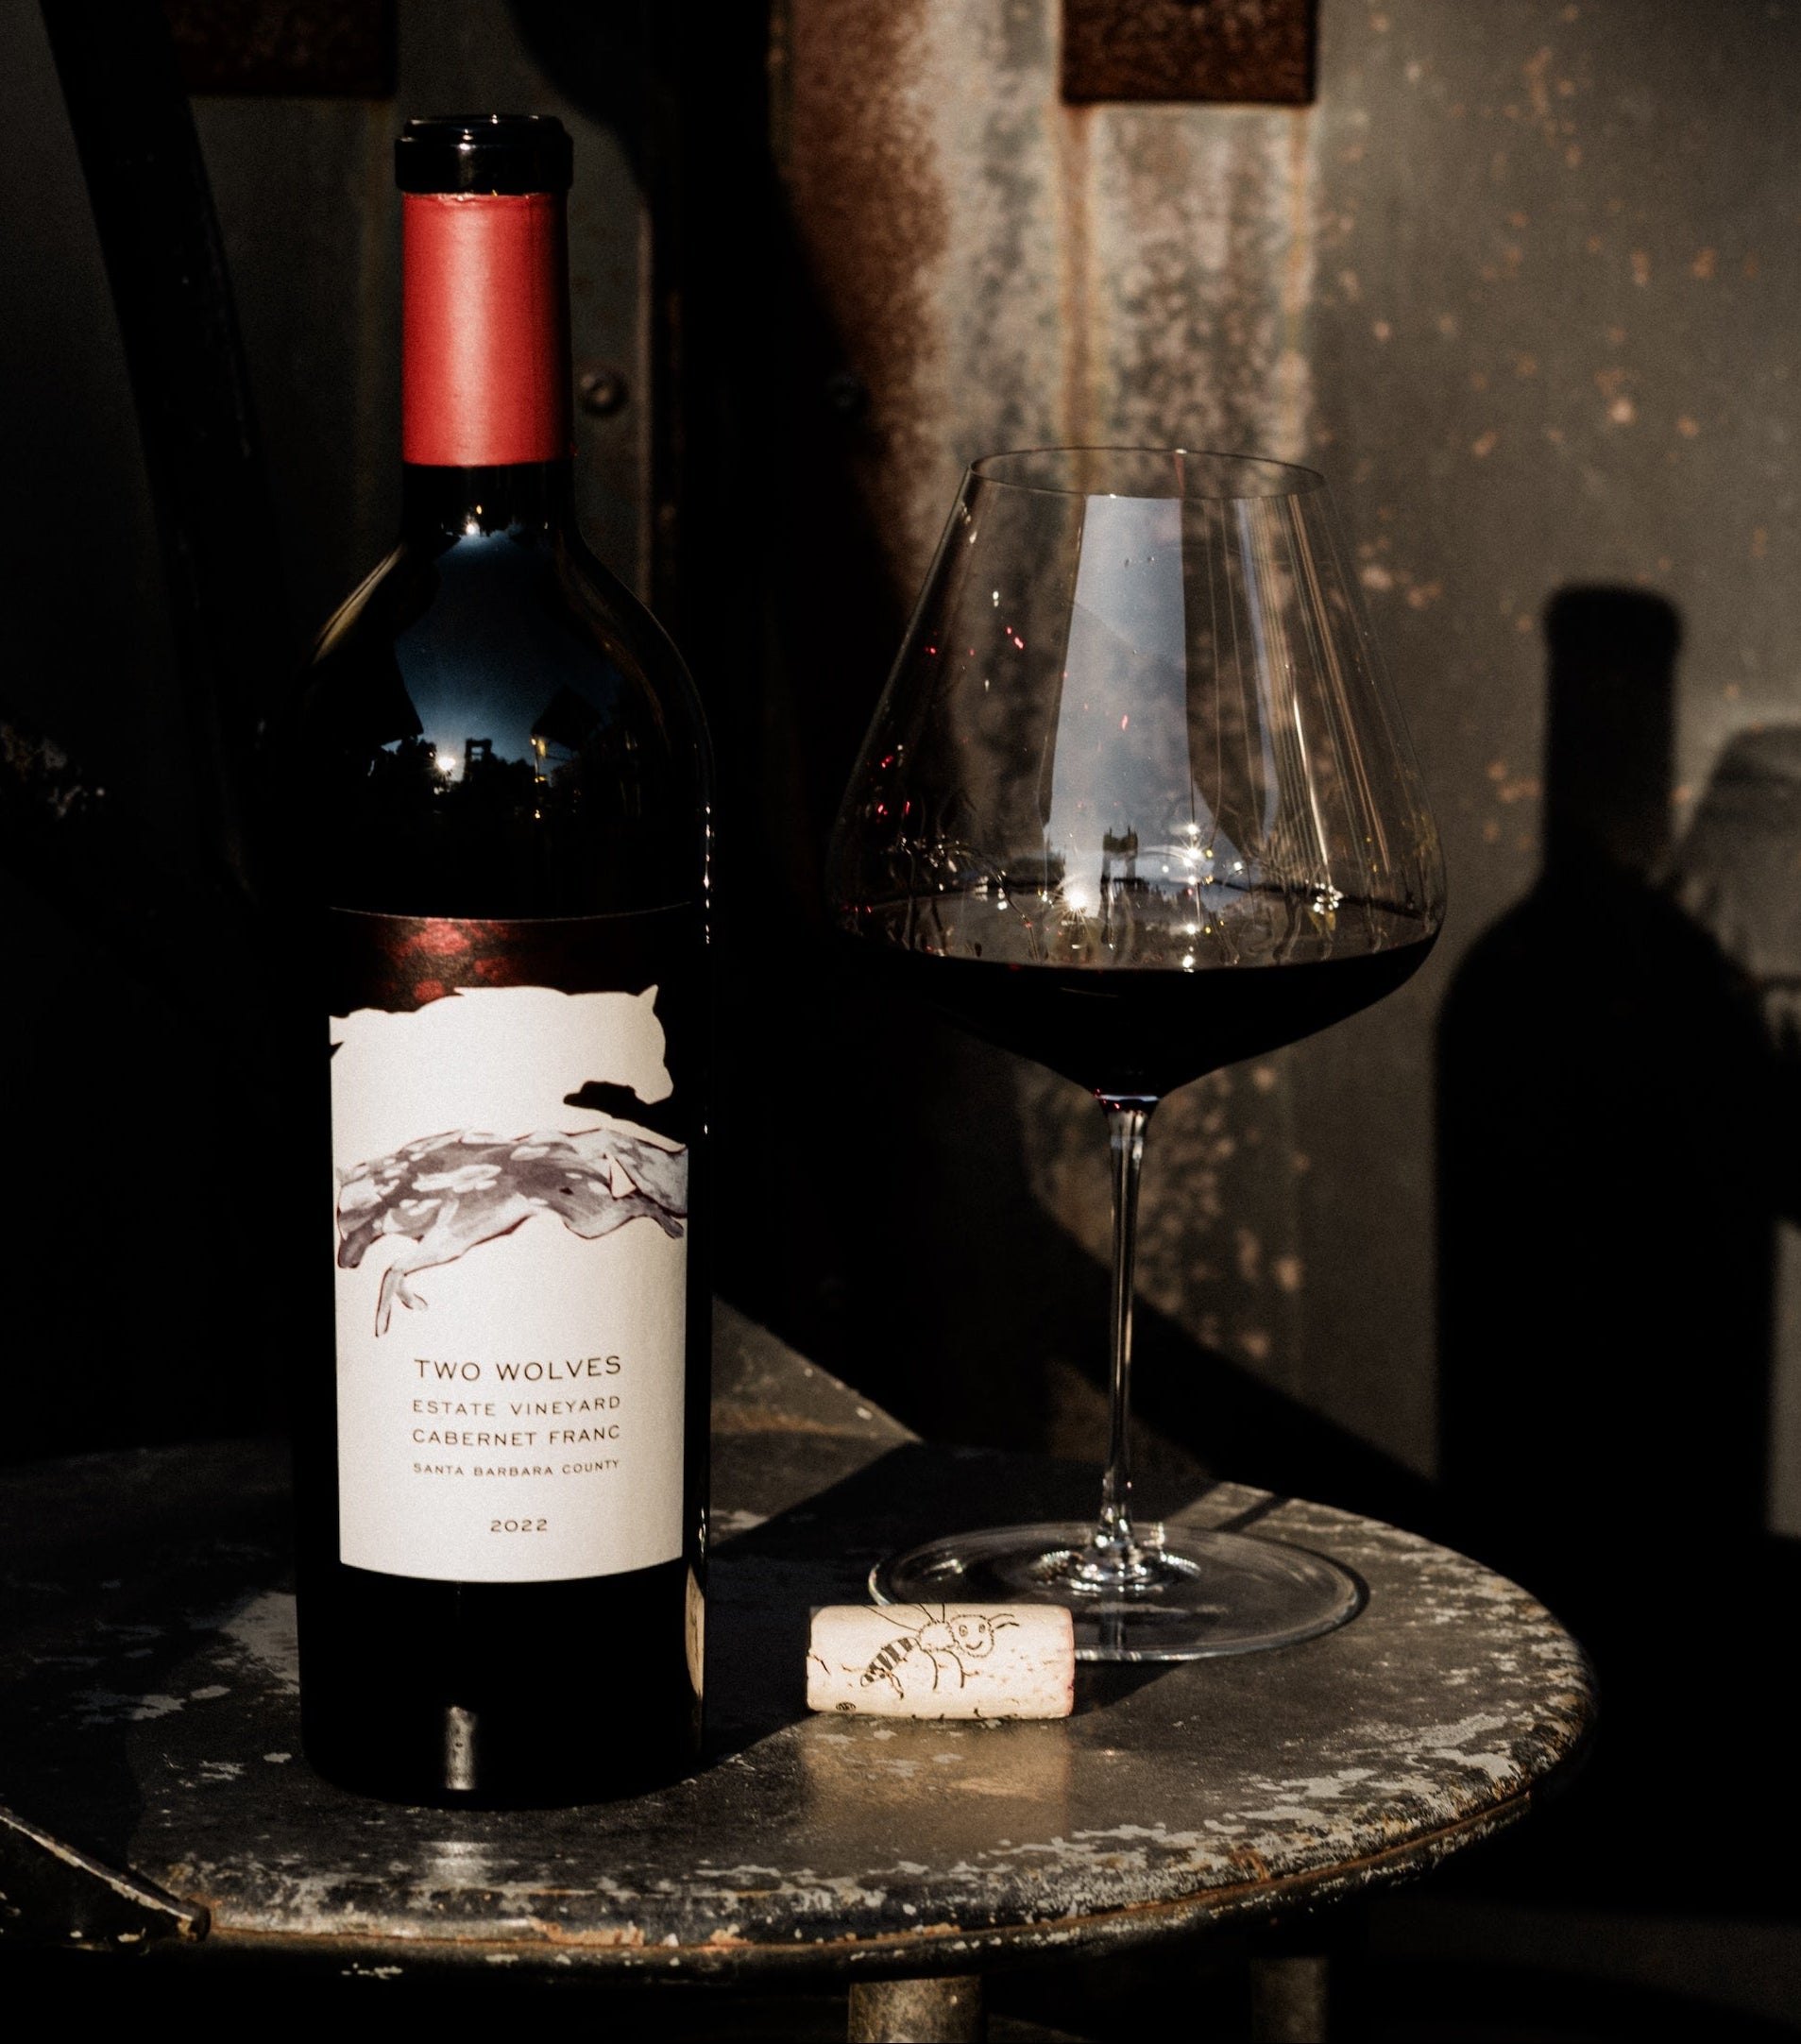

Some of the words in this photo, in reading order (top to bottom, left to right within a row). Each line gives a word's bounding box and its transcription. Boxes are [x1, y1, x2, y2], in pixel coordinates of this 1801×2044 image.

[414, 1358, 481, 1381] TWO
[496, 1355, 621, 1381] WOLVES
[413, 1399, 495, 1416] ESTATE
[510, 1396, 620, 1416] VINEYARD
[412, 1428, 537, 1447] CABERNET
[550, 1424, 620, 1444] FRANC
[414, 1462, 464, 1475] SANTA
[474, 1465, 553, 1476] BARBARA
[562, 1459, 620, 1474] COUNTY
[490, 1518, 549, 1533] 2022
